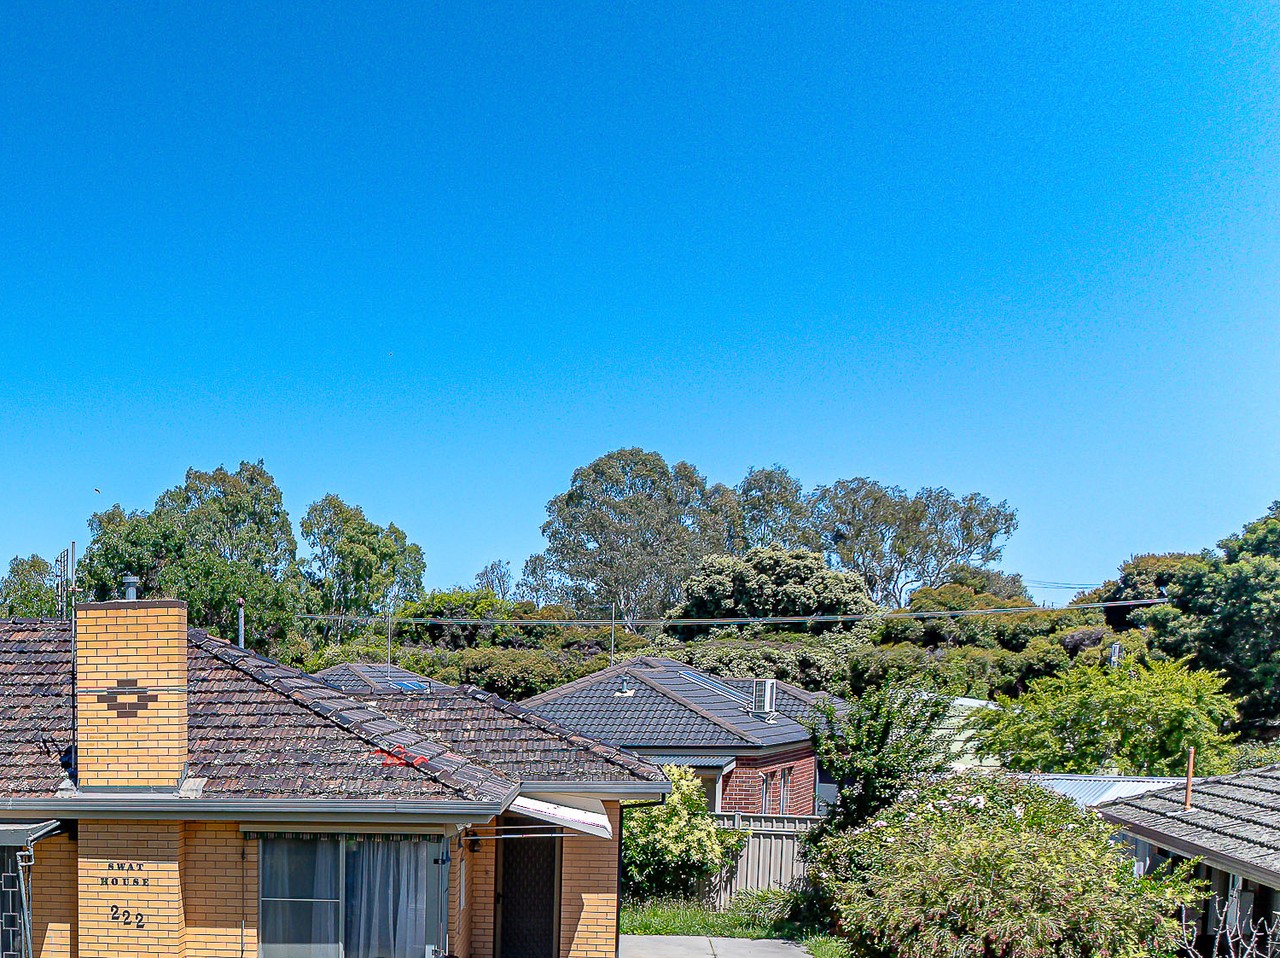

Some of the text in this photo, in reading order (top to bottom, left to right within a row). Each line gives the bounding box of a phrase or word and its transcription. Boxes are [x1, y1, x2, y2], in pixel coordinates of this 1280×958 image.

[108, 863, 144, 871] SWAT
[100, 877, 150, 886] HOUSE
[110, 904, 146, 929] 222
